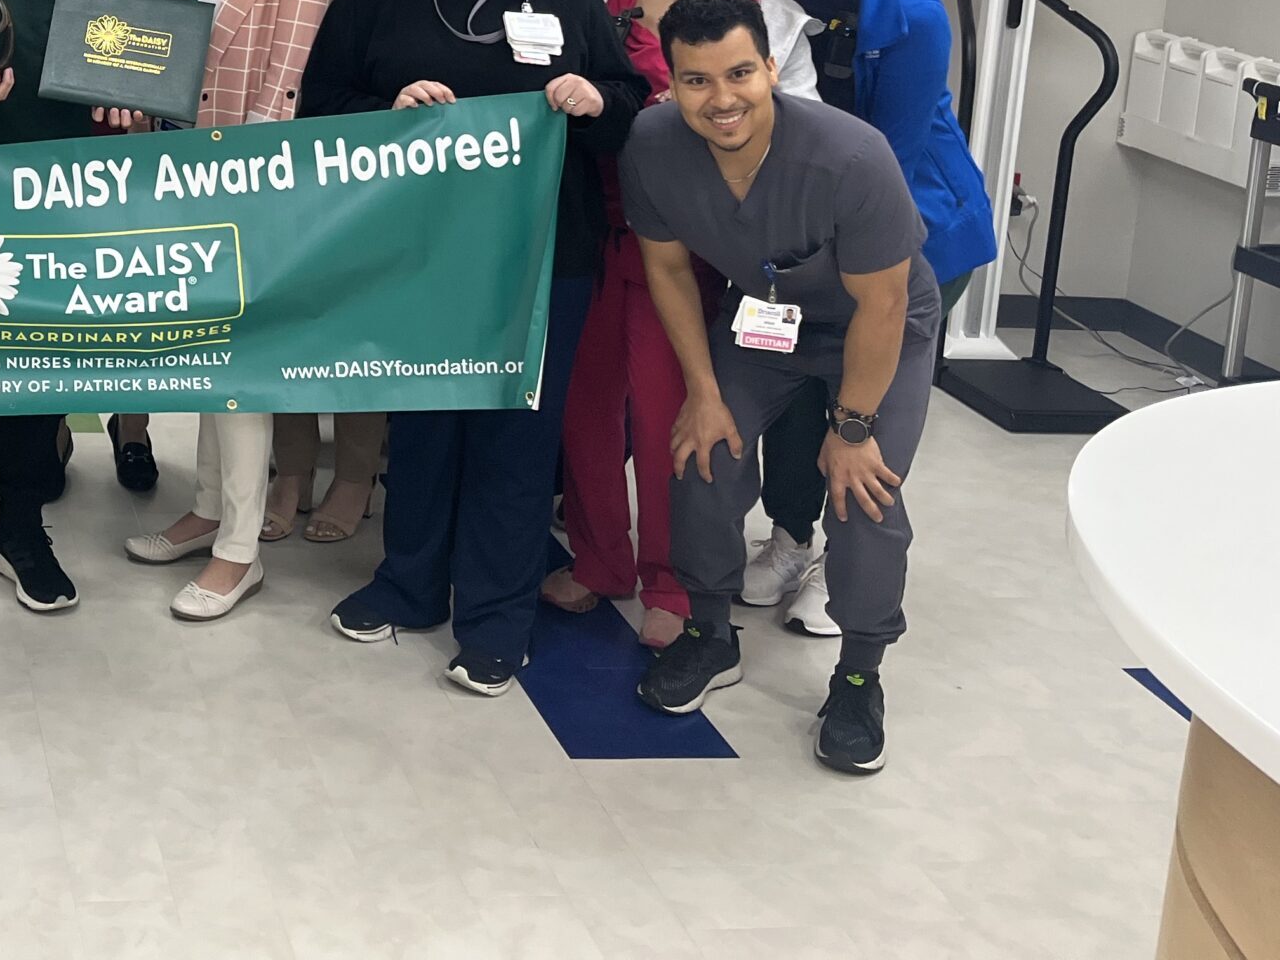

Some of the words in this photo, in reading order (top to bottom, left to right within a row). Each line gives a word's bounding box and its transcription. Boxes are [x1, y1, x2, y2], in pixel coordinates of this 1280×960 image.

[142, 35, 168, 46] DAISY
[13, 157, 133, 210] DAISY
[154, 140, 295, 201] Award
[314, 117, 521, 186] Honoree!
[25, 252, 88, 280] The
[95, 240, 221, 280] DAISY
[151, 323, 232, 343] NURSES
[745, 336, 790, 348] DIETITIAN
[6, 357, 71, 369] NURSES
[76, 351, 232, 369] INTERNATIONALLY
[281, 358, 524, 381] www.DAISYfoundation.or
[27, 380, 51, 393] OF
[56, 380, 69, 393] J.
[73, 379, 143, 392] PATRICK
[147, 377, 212, 391] BARNES
